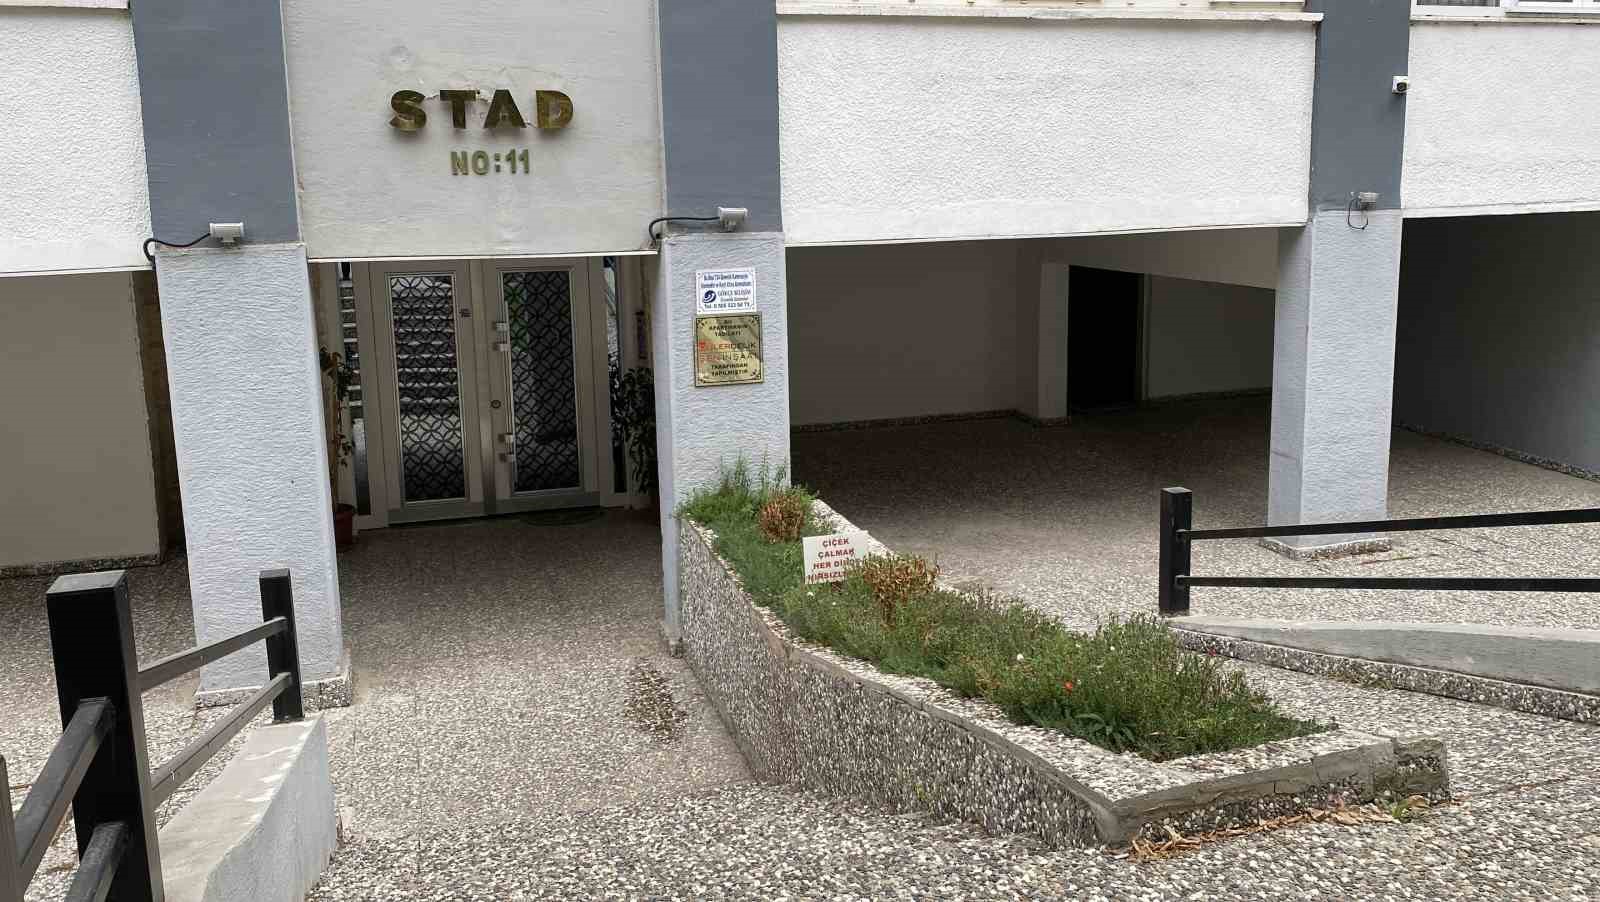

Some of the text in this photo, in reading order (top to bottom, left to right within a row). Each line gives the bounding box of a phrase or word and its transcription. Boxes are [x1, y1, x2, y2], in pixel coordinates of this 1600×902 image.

[390, 89, 574, 132] STAD
[450, 149, 530, 176] NO:11
[818, 548, 855, 560] ÇALMAK
[813, 561, 832, 570] HER
